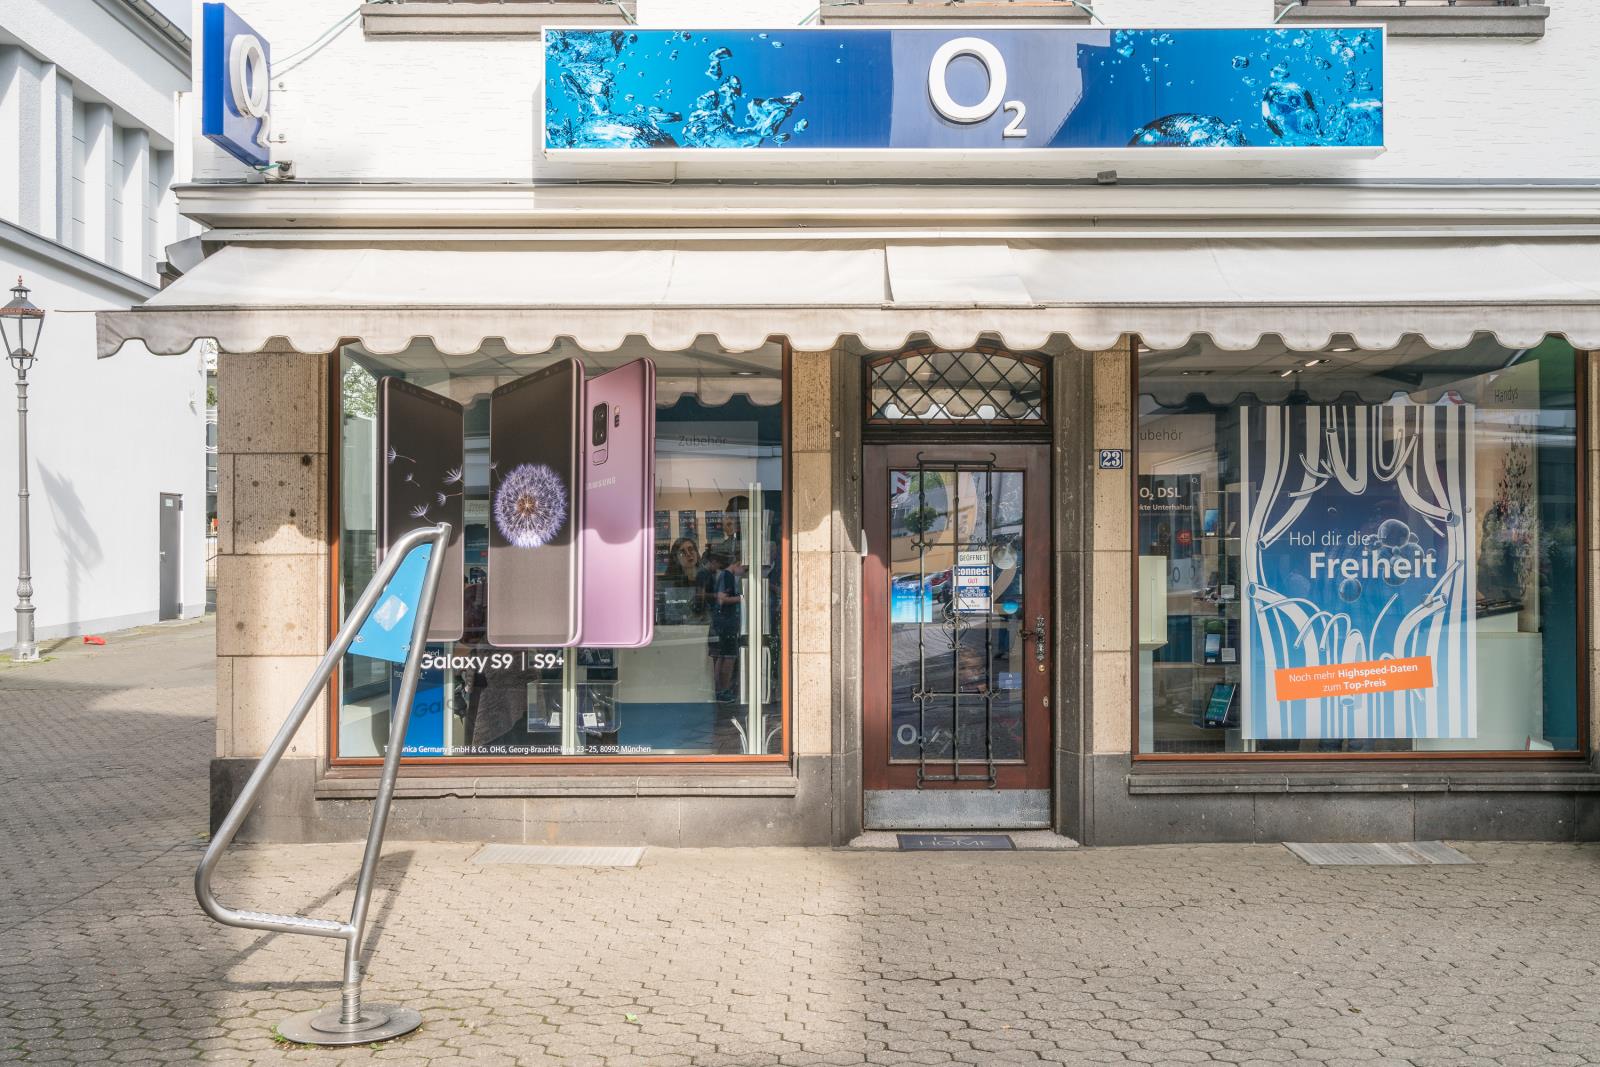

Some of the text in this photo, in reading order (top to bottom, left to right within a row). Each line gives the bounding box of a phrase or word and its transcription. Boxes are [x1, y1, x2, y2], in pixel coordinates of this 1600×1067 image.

[928, 36, 1027, 137] O2
[1137, 429, 1183, 440] ubehör
[1102, 451, 1121, 466] 23
[1157, 487, 1182, 498] DSL
[1289, 531, 1370, 546] Hol dir die
[1310, 551, 1436, 579] Freiheit
[421, 653, 489, 673] Galaxy
[491, 653, 513, 669] S9
[534, 653, 564, 669] S9+
[1288, 663, 1418, 682] Noch mehr Highspeed-Daten
[1322, 679, 1387, 692] zum Top-Preis
[418, 746, 447, 755] Germany
[449, 745, 470, 753] GmbH
[471, 745, 477, 753] &
[478, 745, 489, 753] Co.
[490, 745, 507, 755] OHG,
[600, 745, 620, 753] 80992
[620, 745, 652, 753] München
